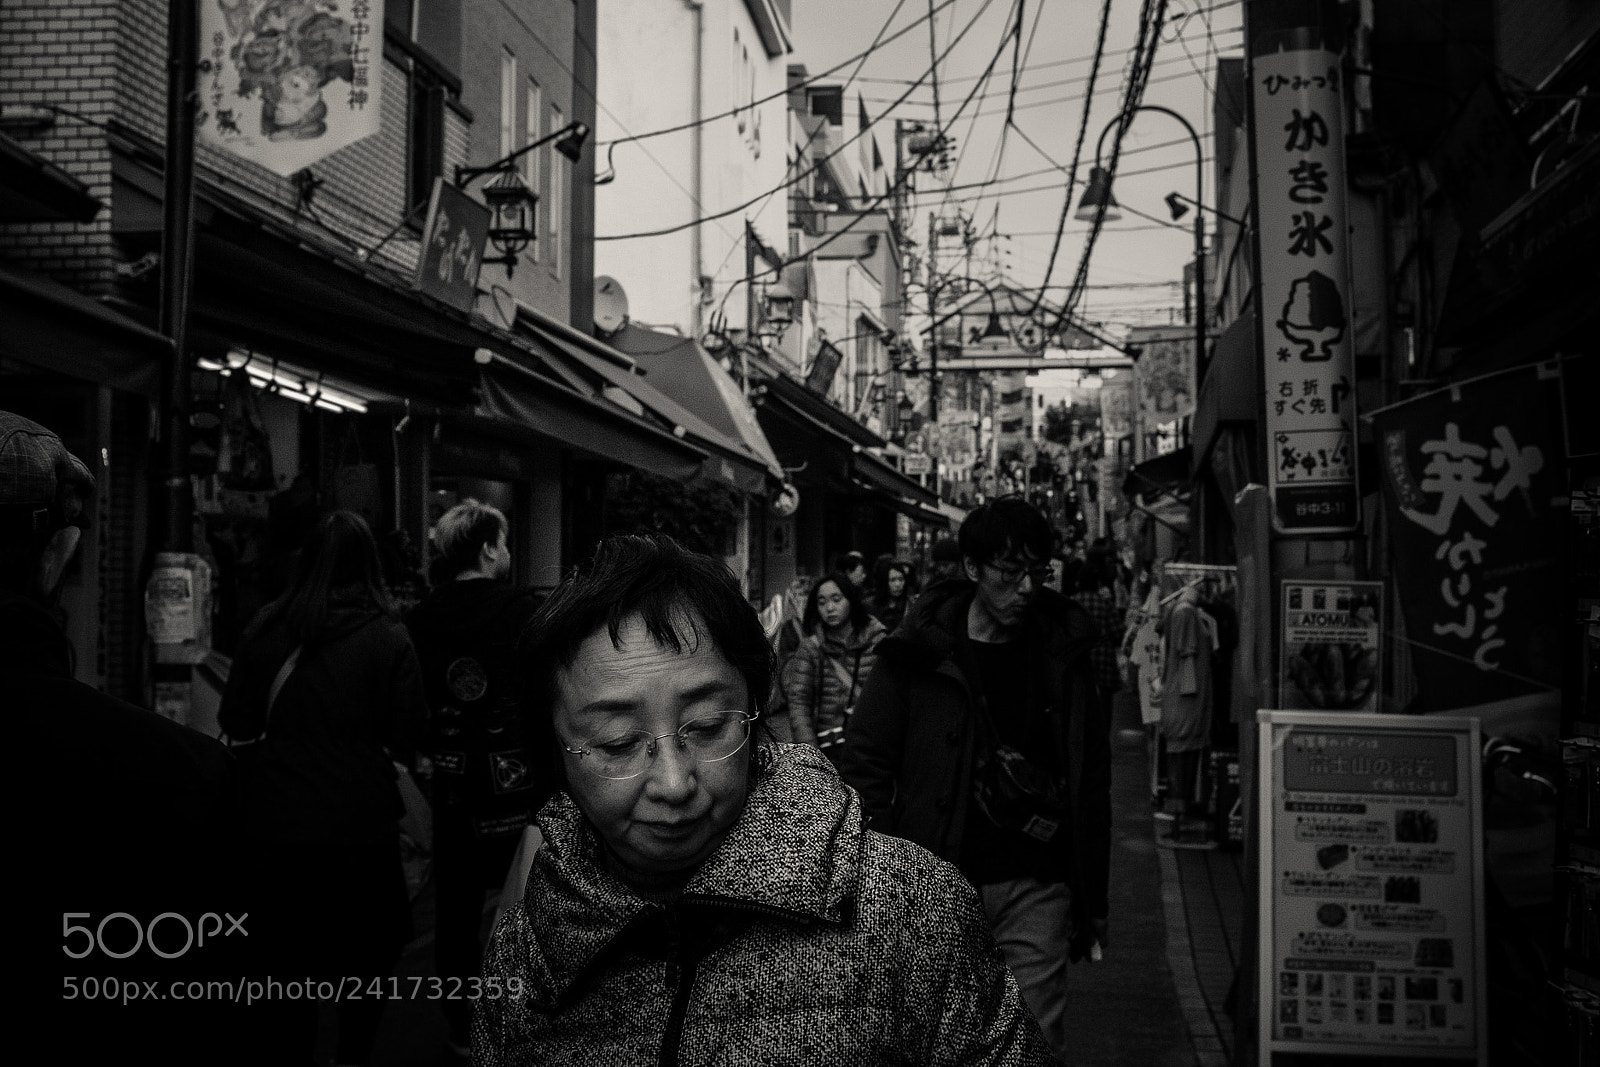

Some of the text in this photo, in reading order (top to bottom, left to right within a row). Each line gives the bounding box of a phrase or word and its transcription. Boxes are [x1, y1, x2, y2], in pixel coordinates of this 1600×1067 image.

[1284, 108, 1334, 258] かき氷
[1279, 379, 1318, 397] 右折
[1275, 398, 1326, 416] すぐ先
[1302, 614, 1348, 626] ATOMU
